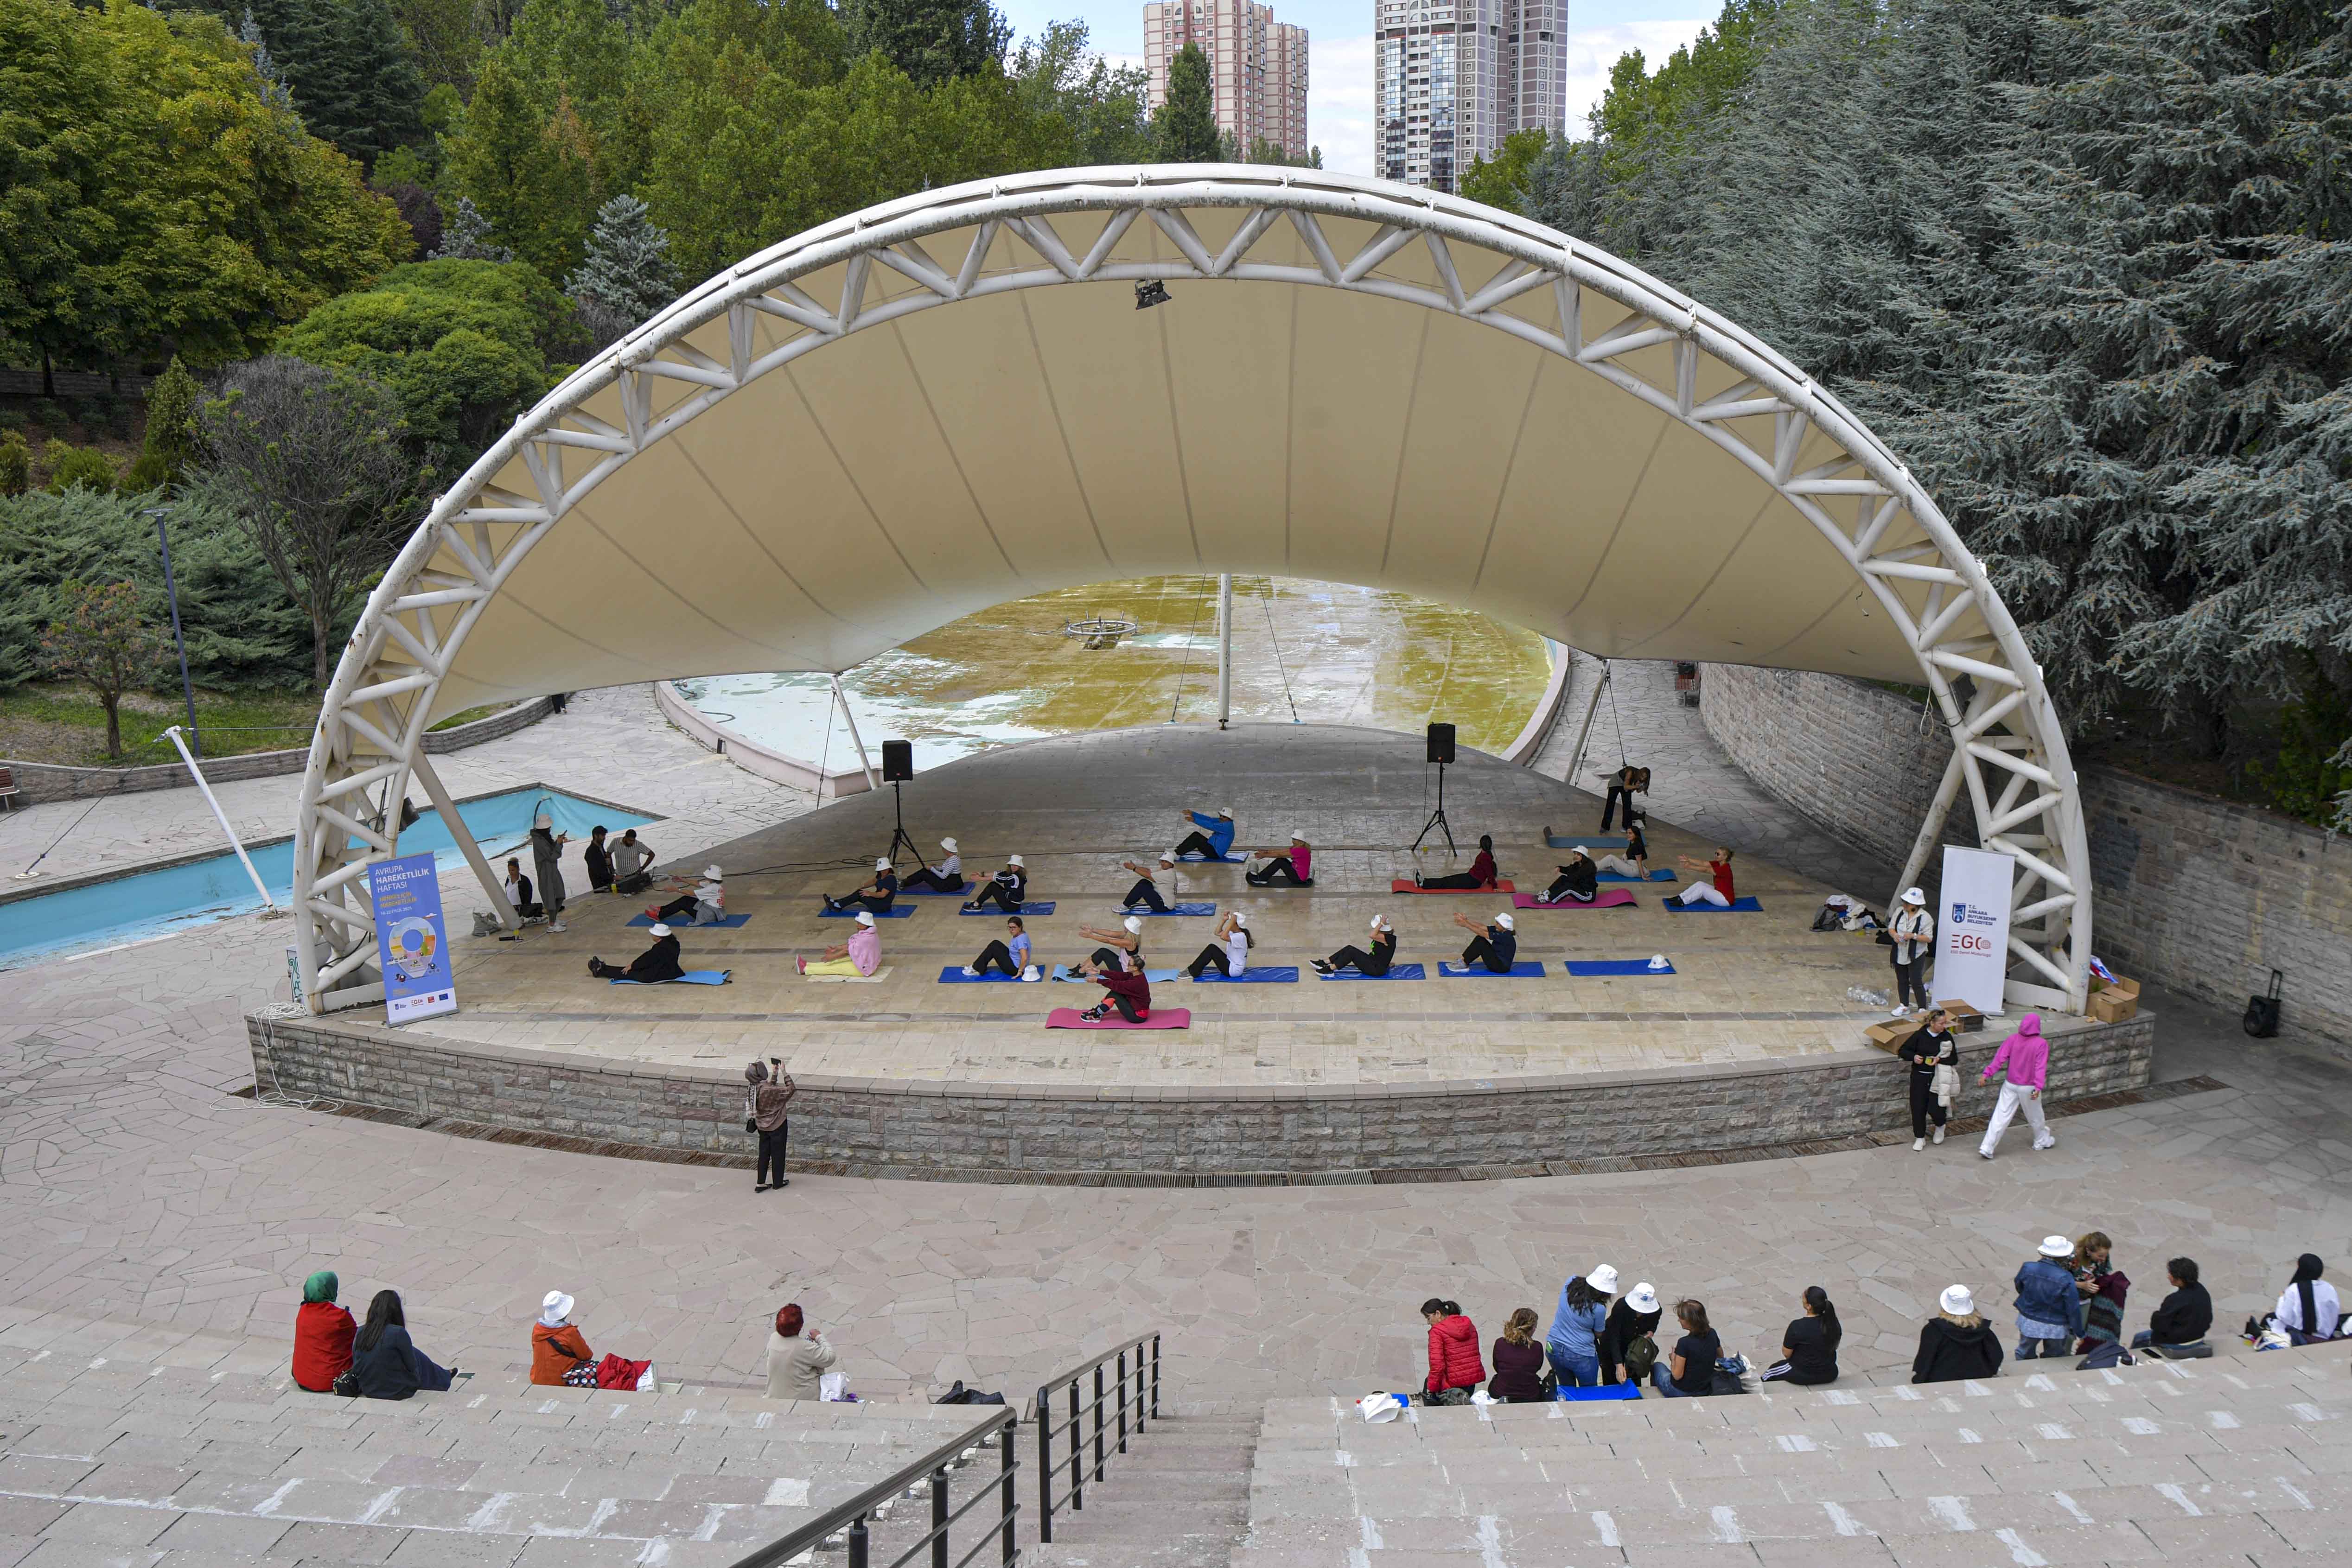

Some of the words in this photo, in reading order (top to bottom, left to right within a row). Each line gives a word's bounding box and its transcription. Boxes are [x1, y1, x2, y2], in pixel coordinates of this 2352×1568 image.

[375, 865, 403, 876] AVRUPA
[376, 867, 430, 885] HAREKETLİLİK
[377, 881, 408, 893] HAFTASI
